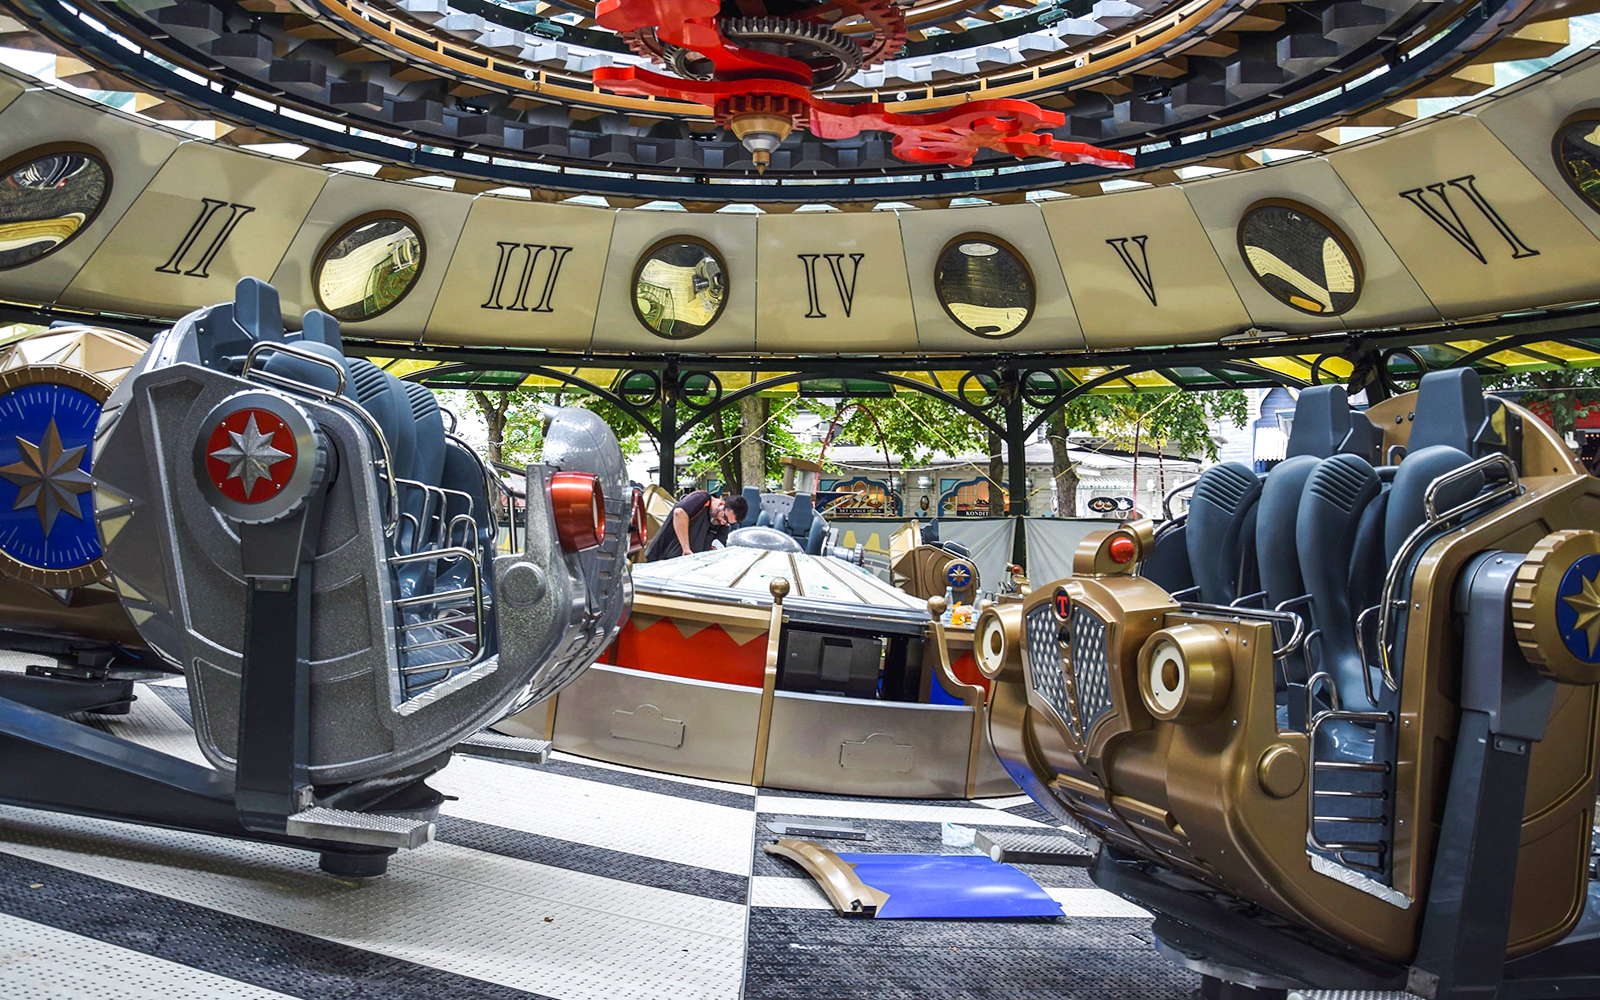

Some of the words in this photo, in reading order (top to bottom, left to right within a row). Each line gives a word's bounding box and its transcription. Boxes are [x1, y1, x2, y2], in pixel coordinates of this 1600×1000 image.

[155, 198, 255, 278] II
[1399, 175, 1540, 264] VI
[481, 242, 573, 312] III
[798, 253, 864, 318] IV
[1106, 235, 1157, 306] V
[1057, 595, 1068, 617] T
